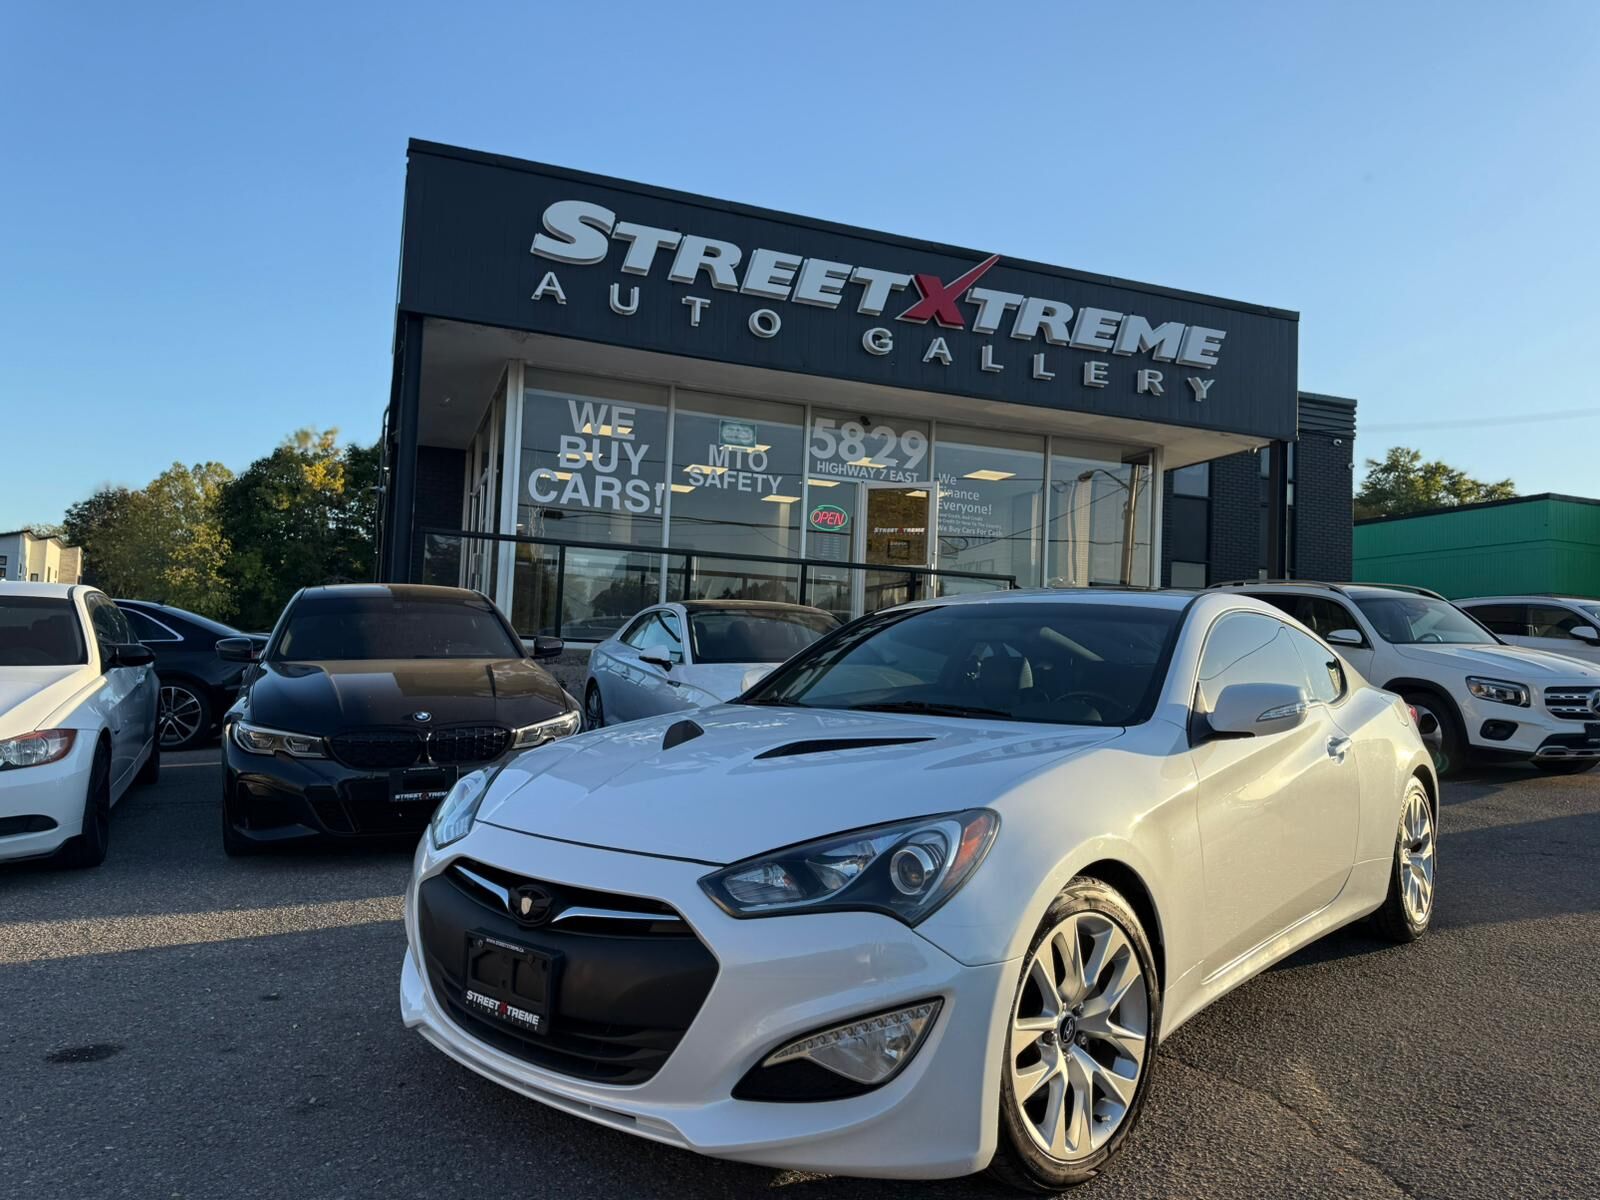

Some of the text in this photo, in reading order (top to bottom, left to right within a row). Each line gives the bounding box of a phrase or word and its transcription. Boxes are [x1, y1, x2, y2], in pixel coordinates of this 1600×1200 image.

[531, 271, 1215, 402] AUTO GALLERY
[567, 400, 636, 441] WE
[559, 435, 650, 476] BUY
[708, 444, 768, 472] MTO
[810, 417, 929, 470] 5829
[688, 467, 783, 494] SAFETY
[816, 460, 919, 484] HIGHWAY 7 EAST
[938, 472, 957, 485] We
[528, 467, 664, 515] CARS!
[812, 510, 845, 525] OPEN
